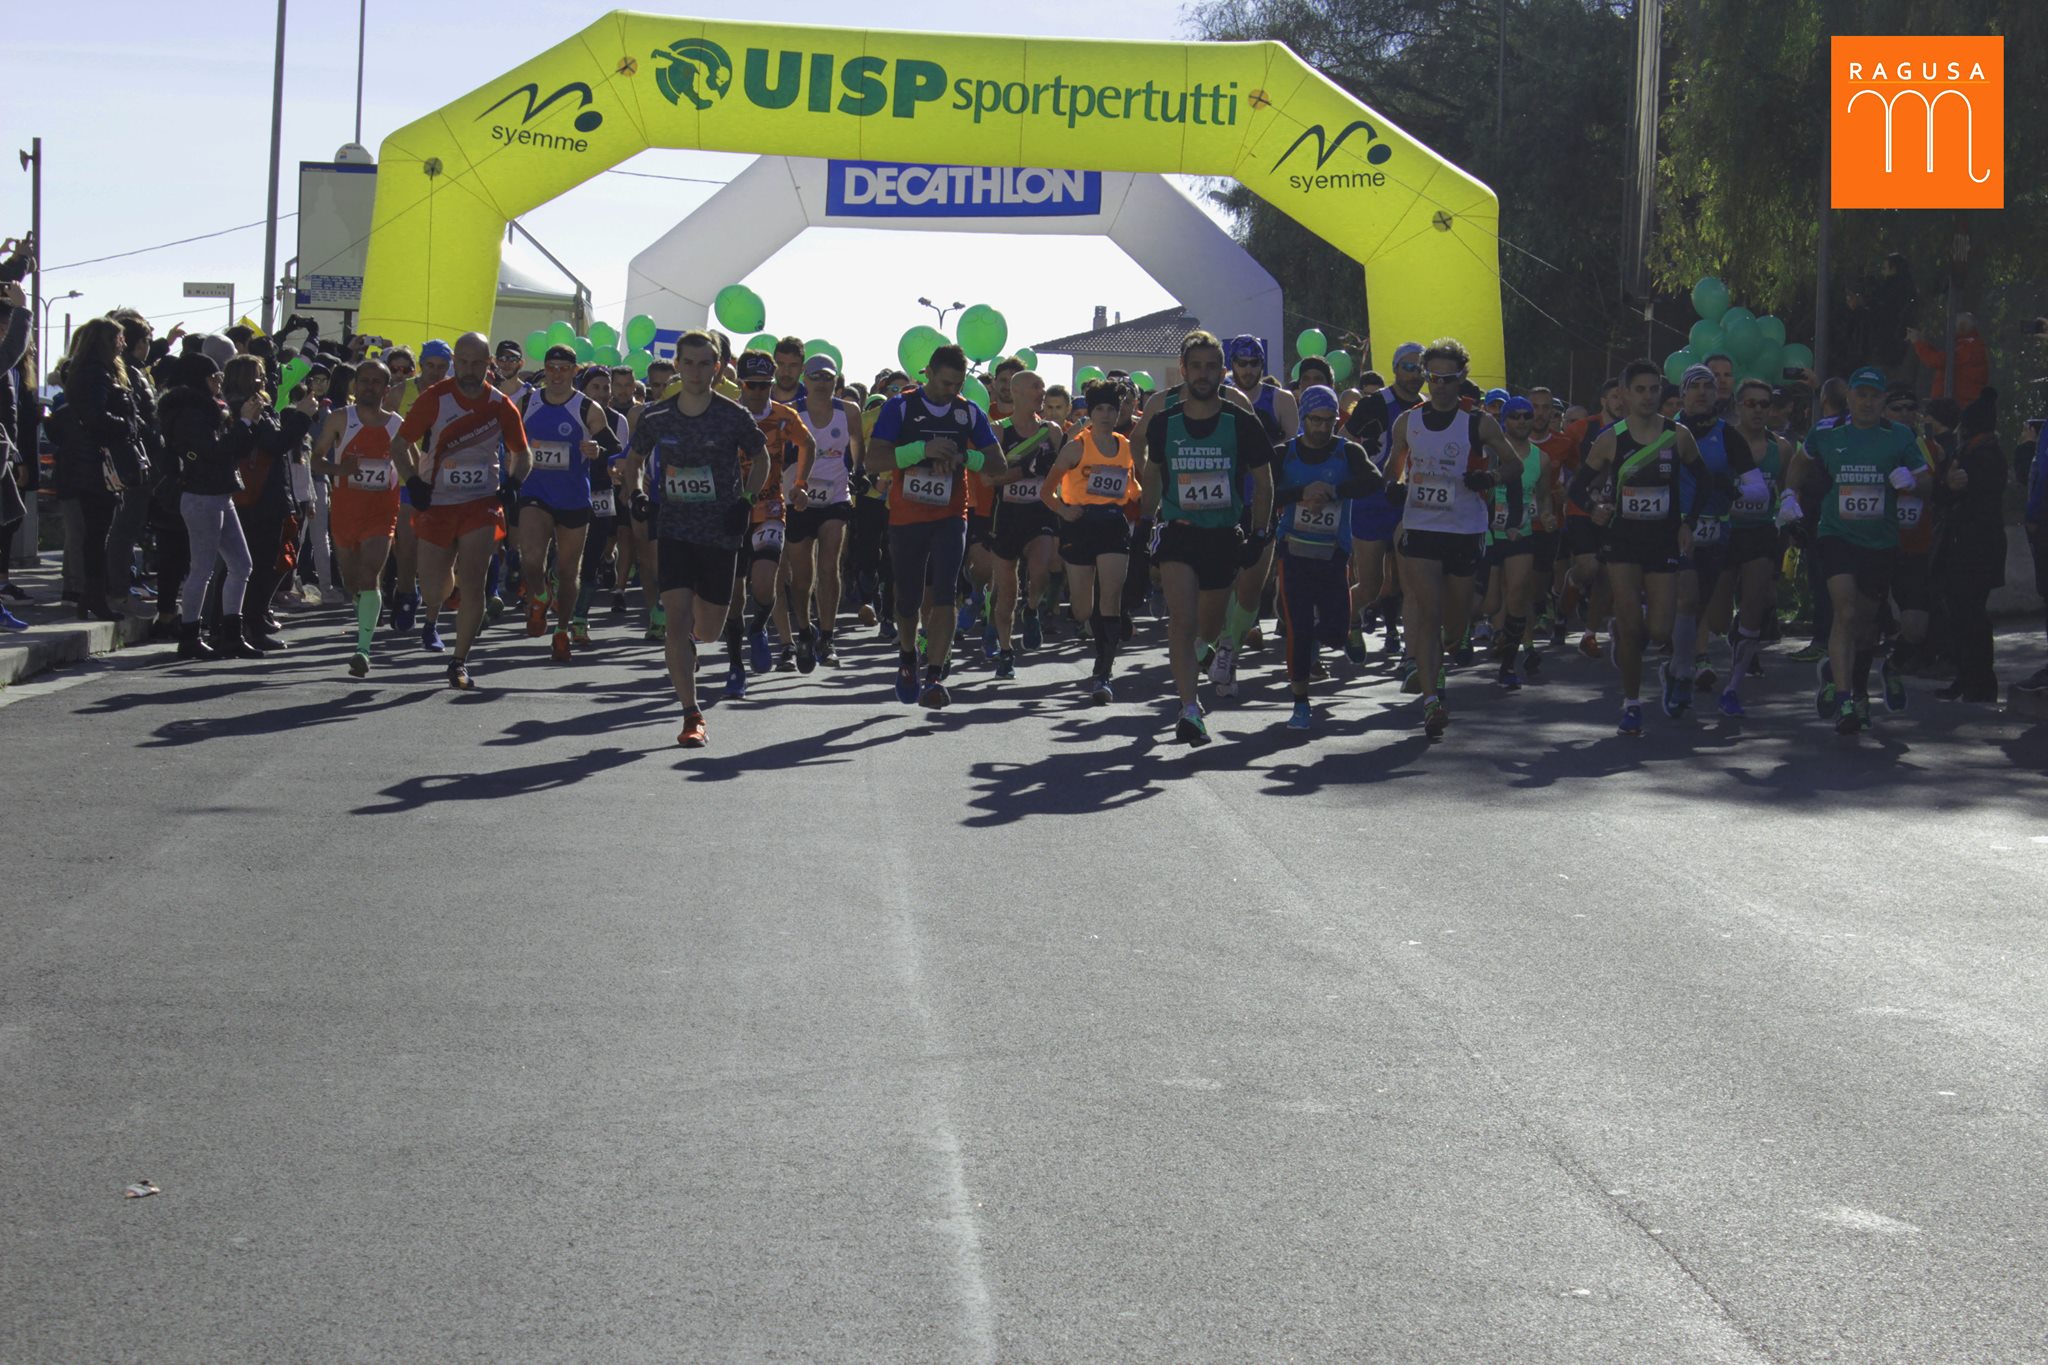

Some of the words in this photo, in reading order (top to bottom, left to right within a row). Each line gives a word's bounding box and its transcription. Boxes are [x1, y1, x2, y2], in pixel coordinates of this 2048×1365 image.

[744, 48, 947, 119] UISP
[952, 75, 1238, 129] sportpertutti
[491, 125, 589, 152] syemme
[844, 167, 1085, 205] DECATHLON
[1290, 172, 1385, 193] syemme
[535, 450, 562, 463] 871
[1178, 447, 1223, 456] ATLETICA
[1171, 458, 1231, 470] AUGUSTA
[1840, 464, 1877, 472] ATLETICA
[354, 470, 386, 483] 674
[449, 470, 484, 484] 632
[1092, 476, 1122, 491] 890
[1835, 473, 1885, 483] AUGUSTA
[668, 480, 711, 494] 1195
[909, 479, 946, 497] 646
[1009, 484, 1037, 497] 804
[1185, 484, 1224, 501] 414
[807, 488, 828, 502] 44
[1417, 487, 1448, 503] 578
[592, 499, 609, 511] 60
[1628, 499, 1661, 512] 821
[1845, 497, 1879, 512] 667
[1301, 509, 1335, 527] 526
[1897, 508, 1918, 521] 35
